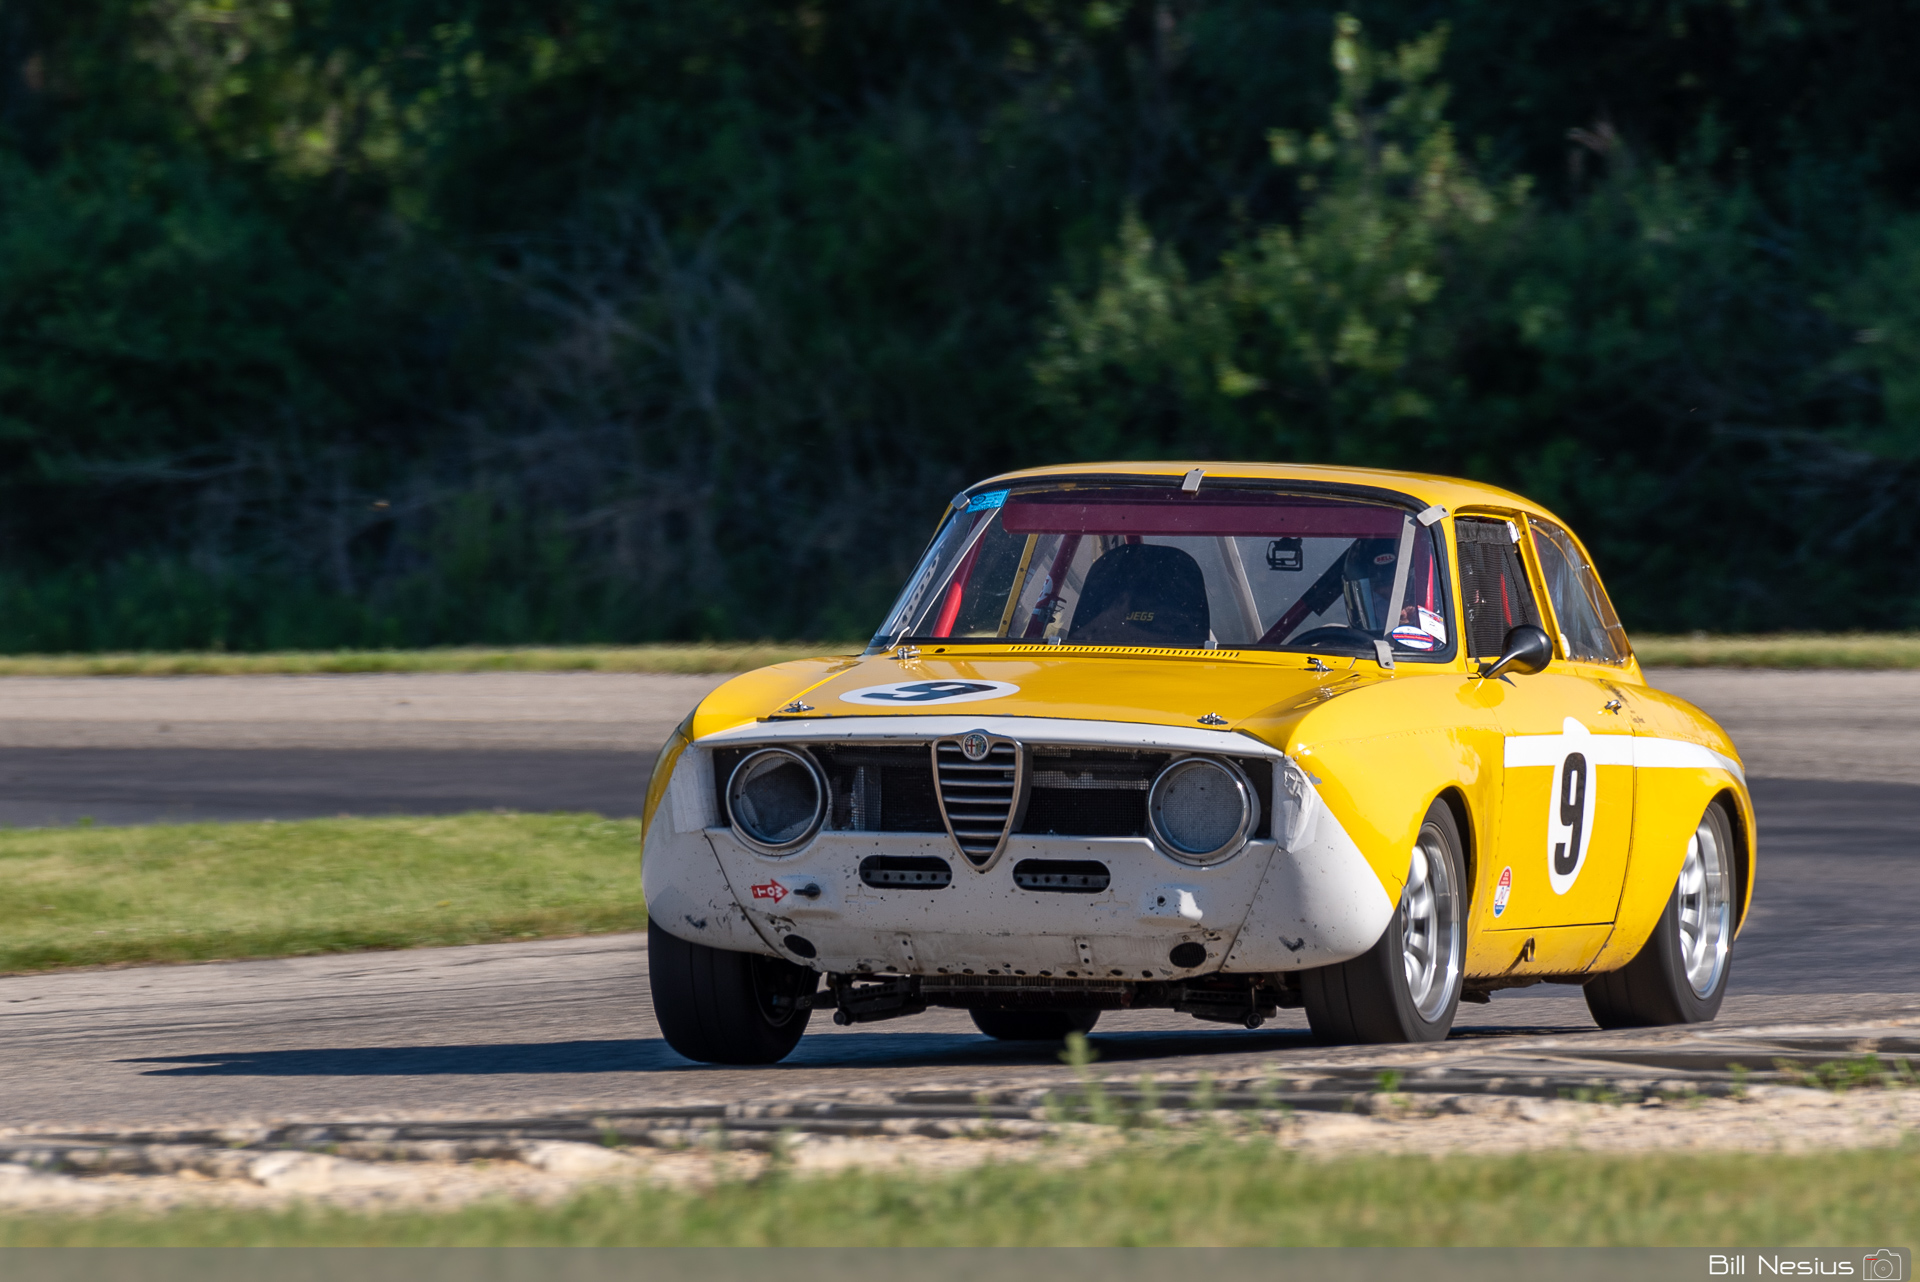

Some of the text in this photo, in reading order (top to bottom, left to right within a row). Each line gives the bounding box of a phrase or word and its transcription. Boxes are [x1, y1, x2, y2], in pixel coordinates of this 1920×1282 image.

[1126, 611, 1155, 621] JEGS
[861, 682, 998, 701] 9
[1554, 752, 1587, 875] 9
[757, 885, 784, 898] TOW
